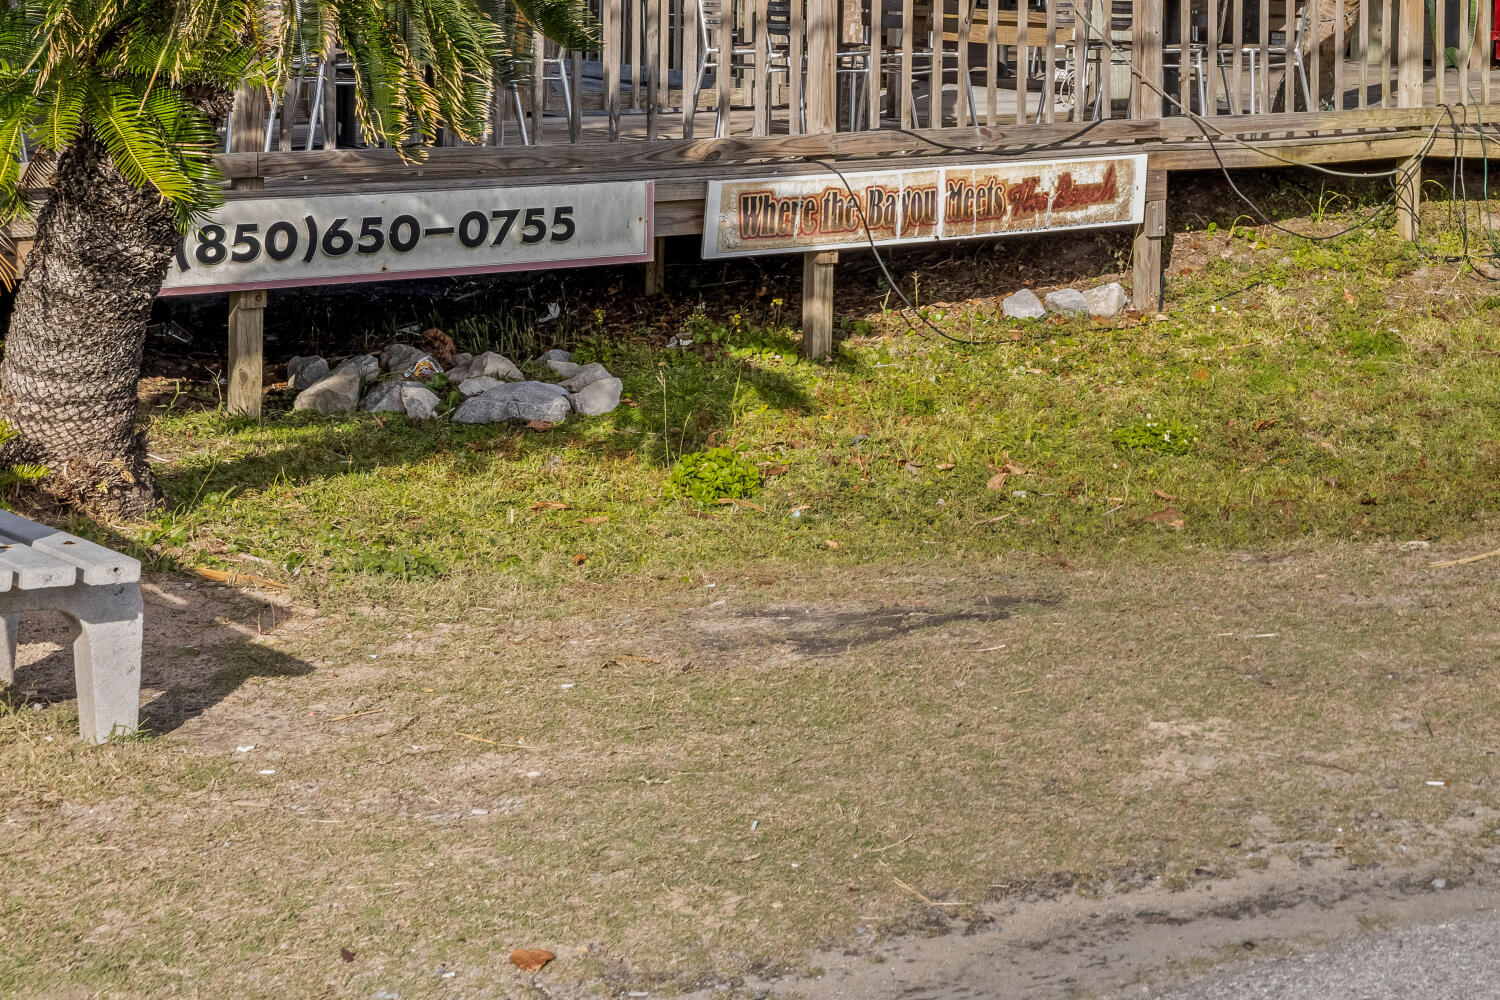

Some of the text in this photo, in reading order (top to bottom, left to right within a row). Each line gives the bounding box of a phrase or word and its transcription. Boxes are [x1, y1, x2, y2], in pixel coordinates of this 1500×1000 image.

[739, 191, 817, 239] Where
[820, 187, 859, 233] the
[866, 185, 939, 235] Bayou
[944, 176, 1006, 223] Meets
